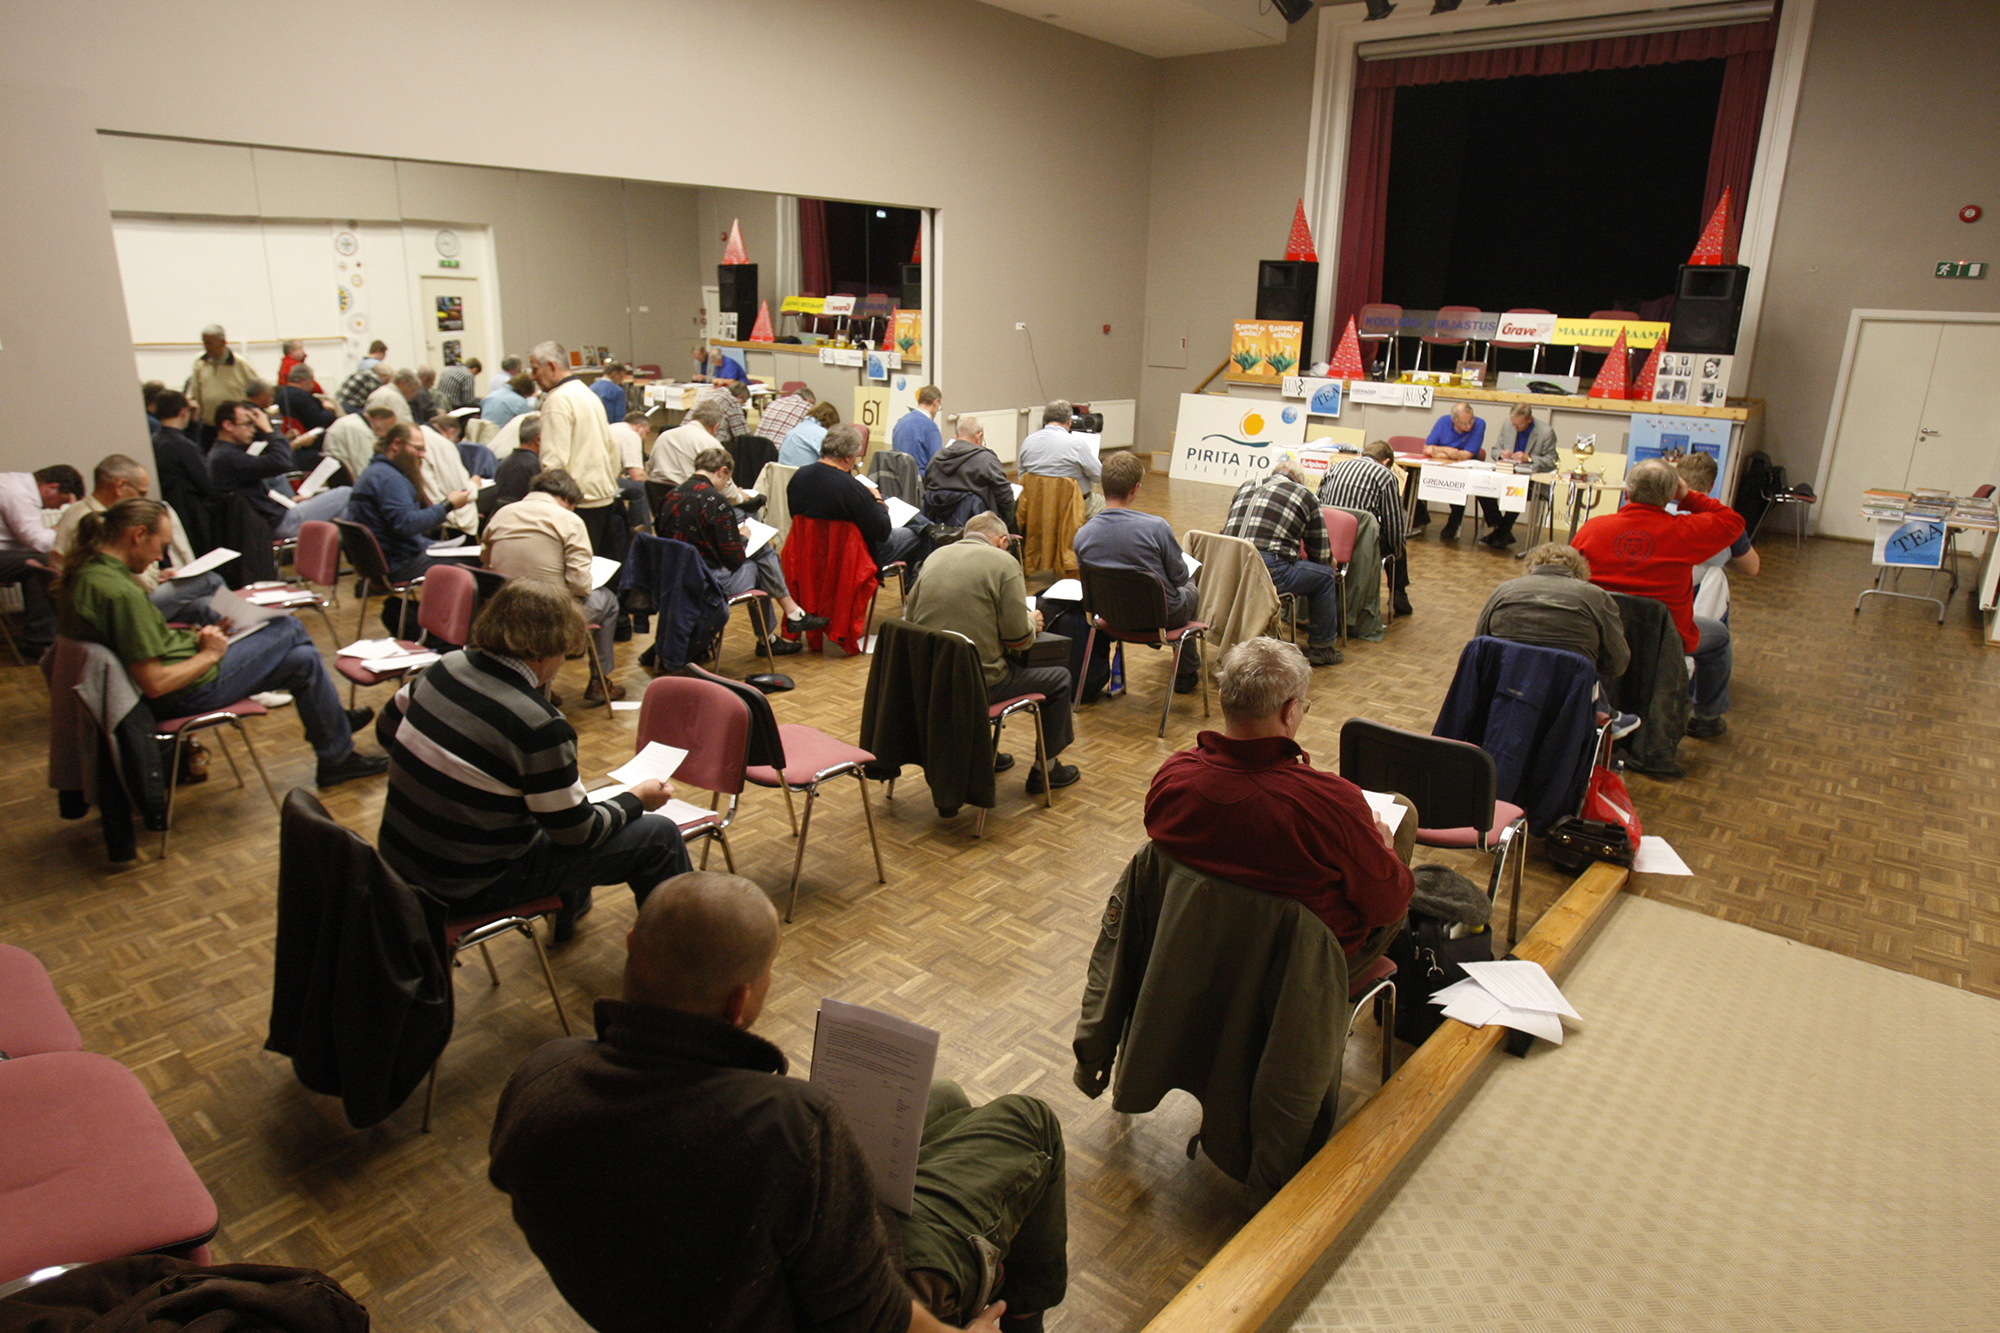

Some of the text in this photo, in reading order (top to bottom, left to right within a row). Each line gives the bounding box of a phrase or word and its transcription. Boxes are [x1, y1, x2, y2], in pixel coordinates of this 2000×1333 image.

[1365, 316, 1496, 331] KOOLIBRI KIRJASTUS
[1502, 322, 1537, 336] Grave
[1624, 331, 1660, 339] RAAM
[1314, 387, 1340, 406] TEA
[1405, 386, 1432, 406] KUNST
[1187, 447, 1270, 469] PIRITA TO
[1422, 477, 1466, 490] GRENADER
[1893, 524, 1942, 553] TEA
